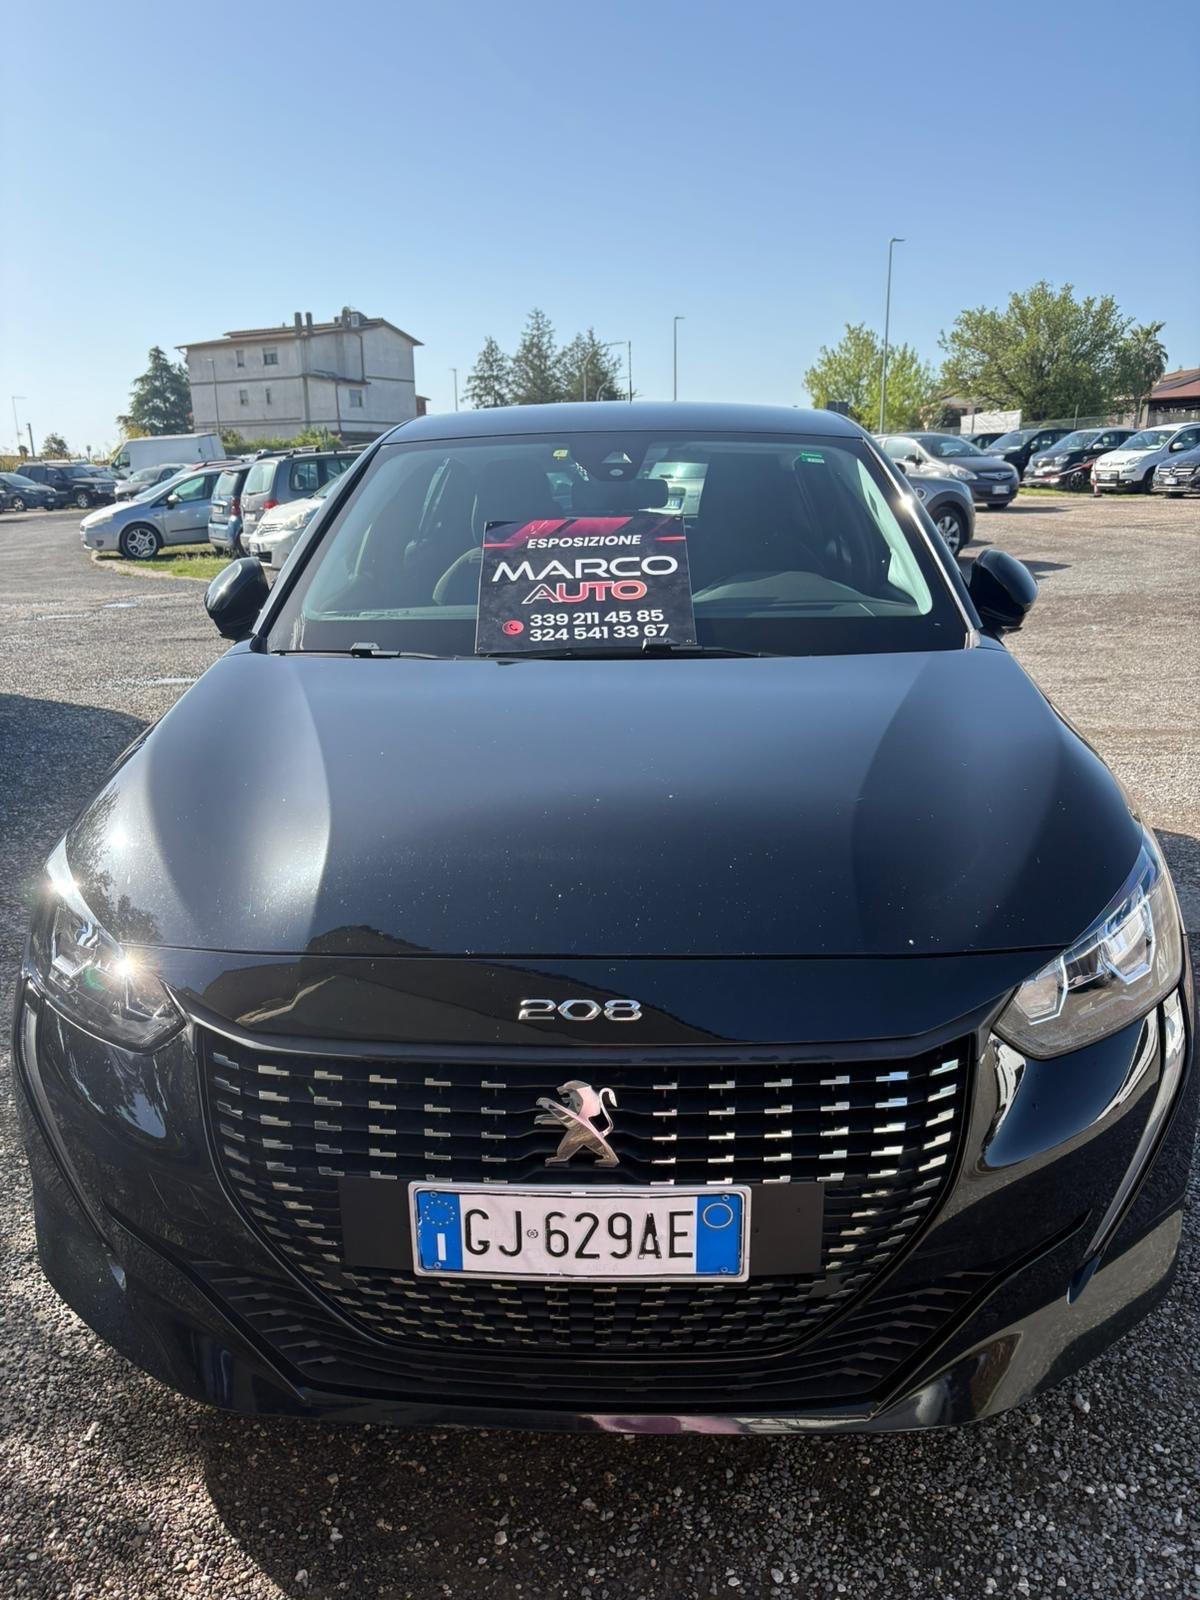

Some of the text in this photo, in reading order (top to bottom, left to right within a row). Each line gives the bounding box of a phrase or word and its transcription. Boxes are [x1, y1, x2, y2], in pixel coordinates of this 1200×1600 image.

[527, 535, 642, 549] ESPOSIZIONE
[492, 555, 678, 582] MARCO
[521, 580, 647, 604] AUTO
[530, 609, 664, 626] 339 211 45 85
[529, 624, 669, 642] 324 541 33 67
[518, 999, 642, 1021] 208
